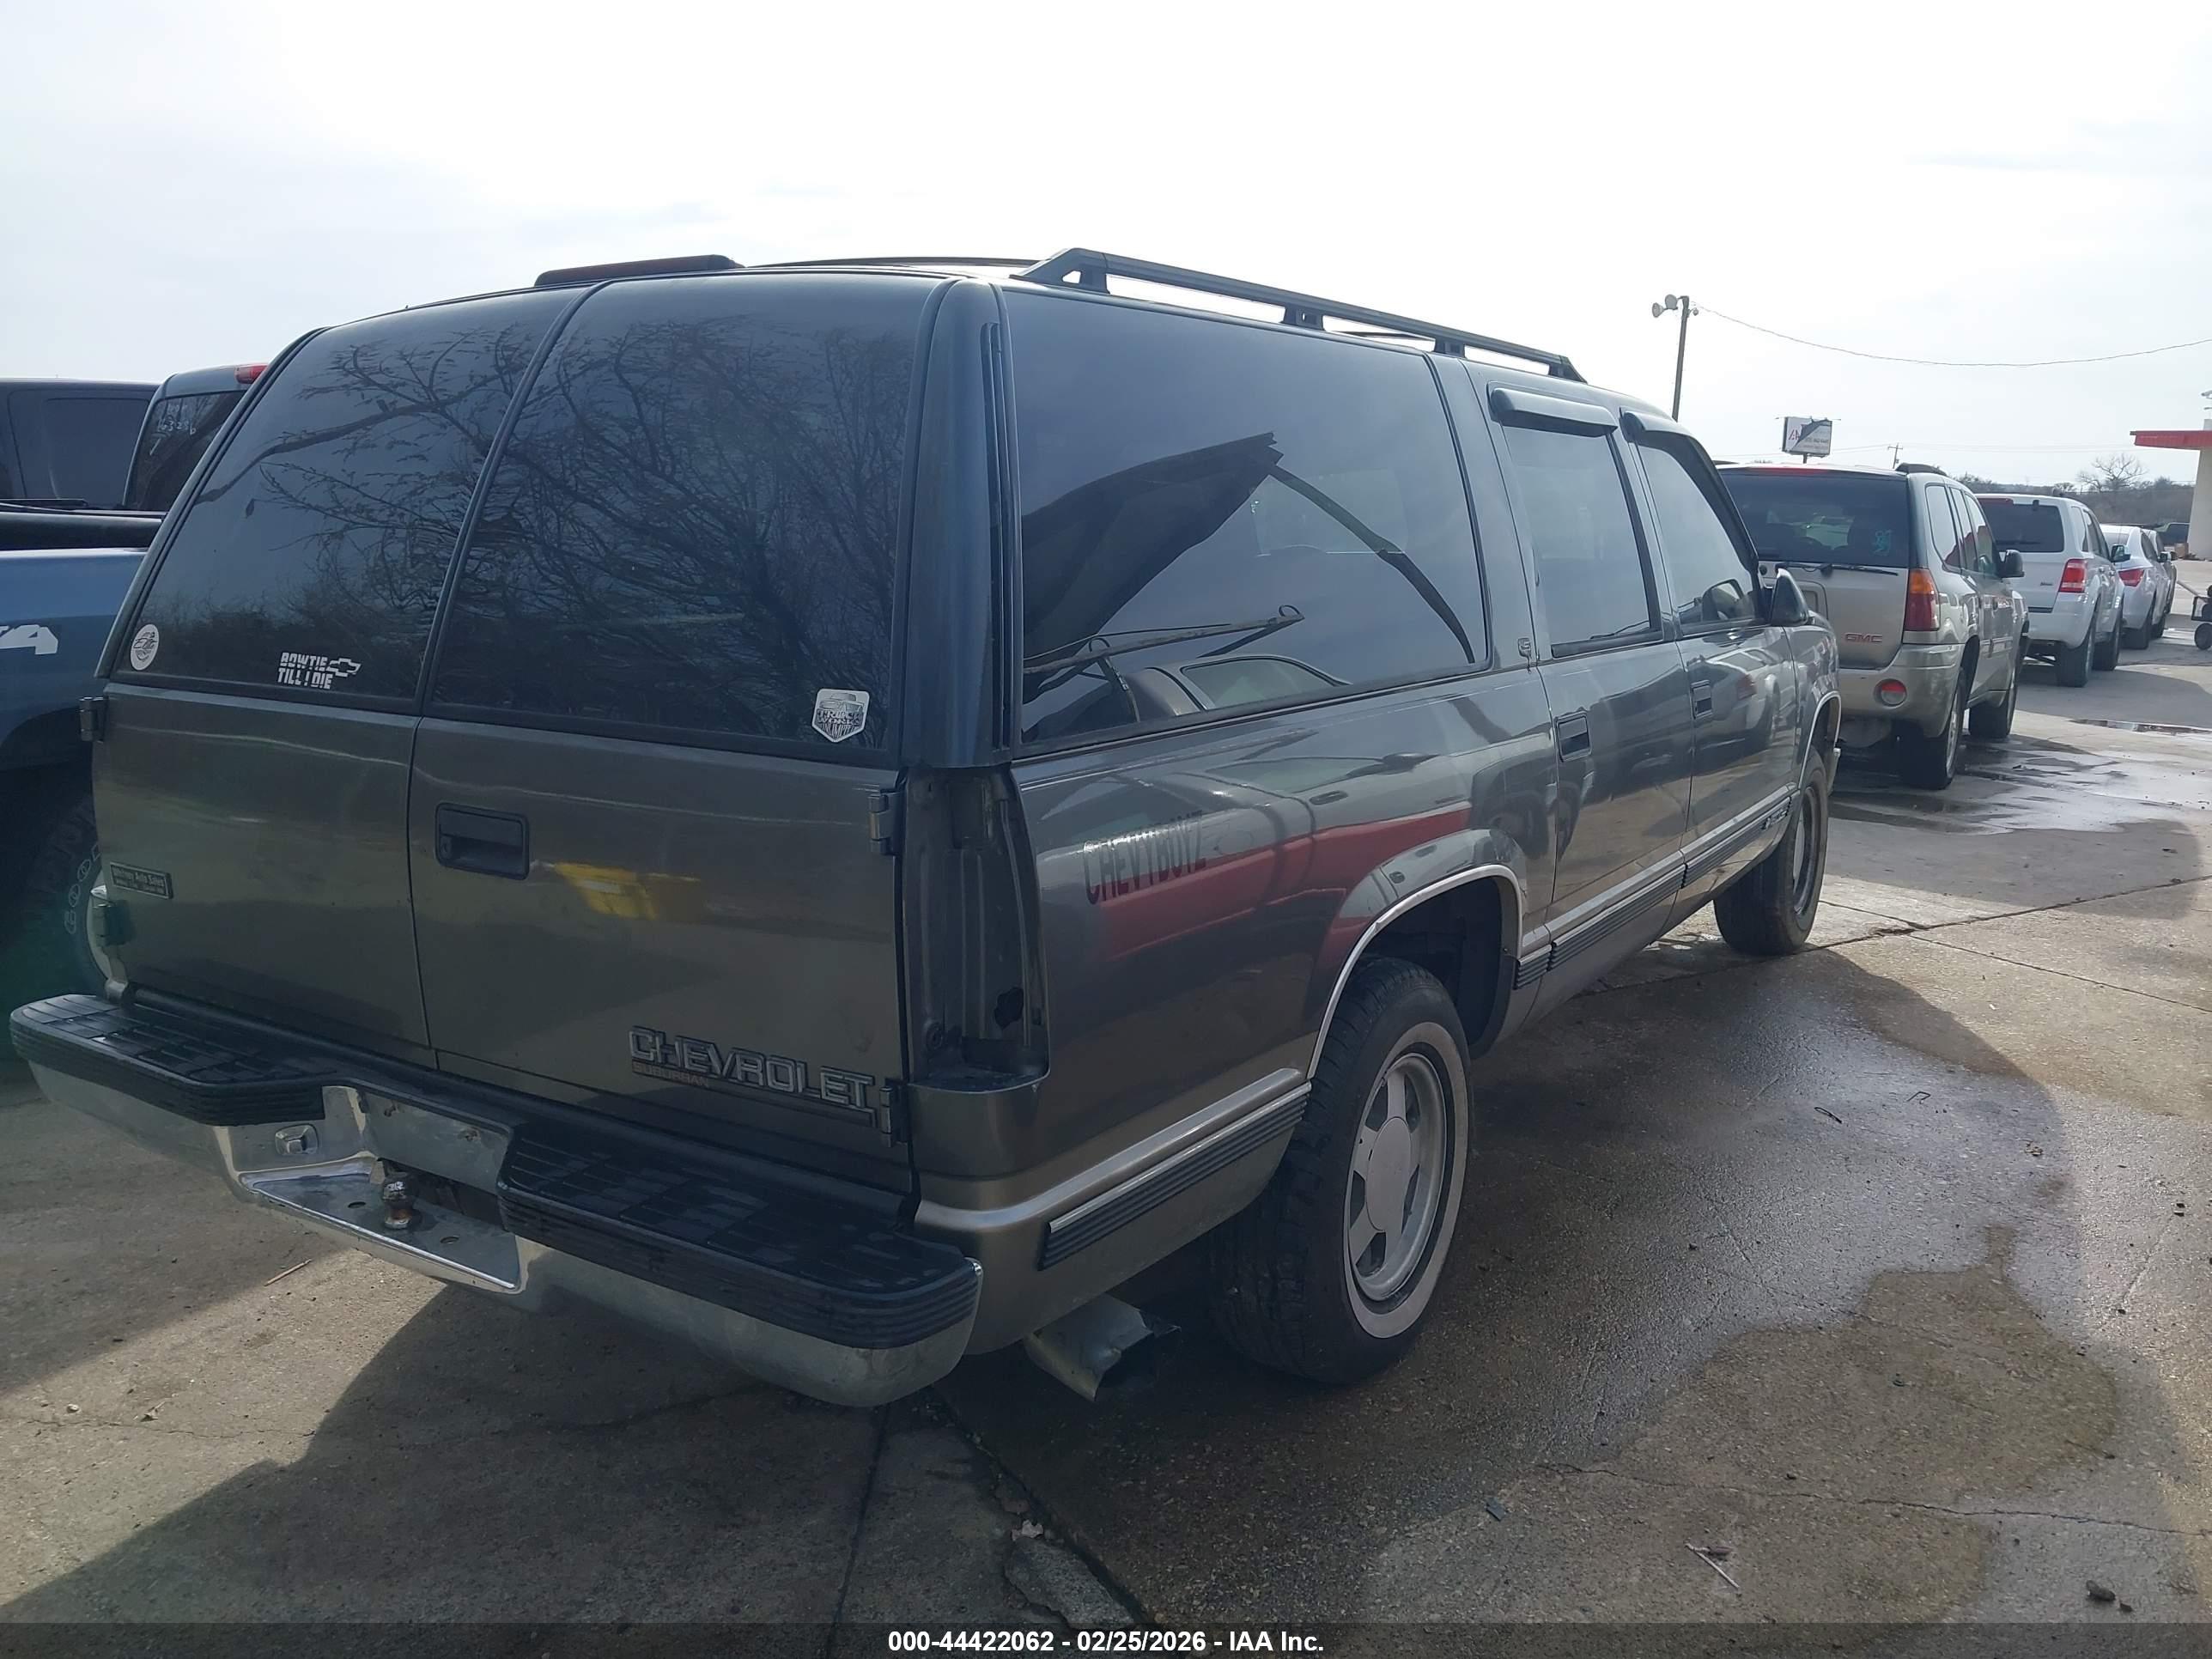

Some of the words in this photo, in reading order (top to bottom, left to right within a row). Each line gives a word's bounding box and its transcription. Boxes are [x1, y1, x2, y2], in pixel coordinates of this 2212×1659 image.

[1845, 632, 1882, 643] GMC
[279, 652, 328, 671] BOWTIE
[277, 667, 301, 686] TILL
[310, 672, 333, 690] DIE
[629, 1026, 875, 1109] CHEVROLET
[632, 1060, 709, 1089] SUBURBAN
